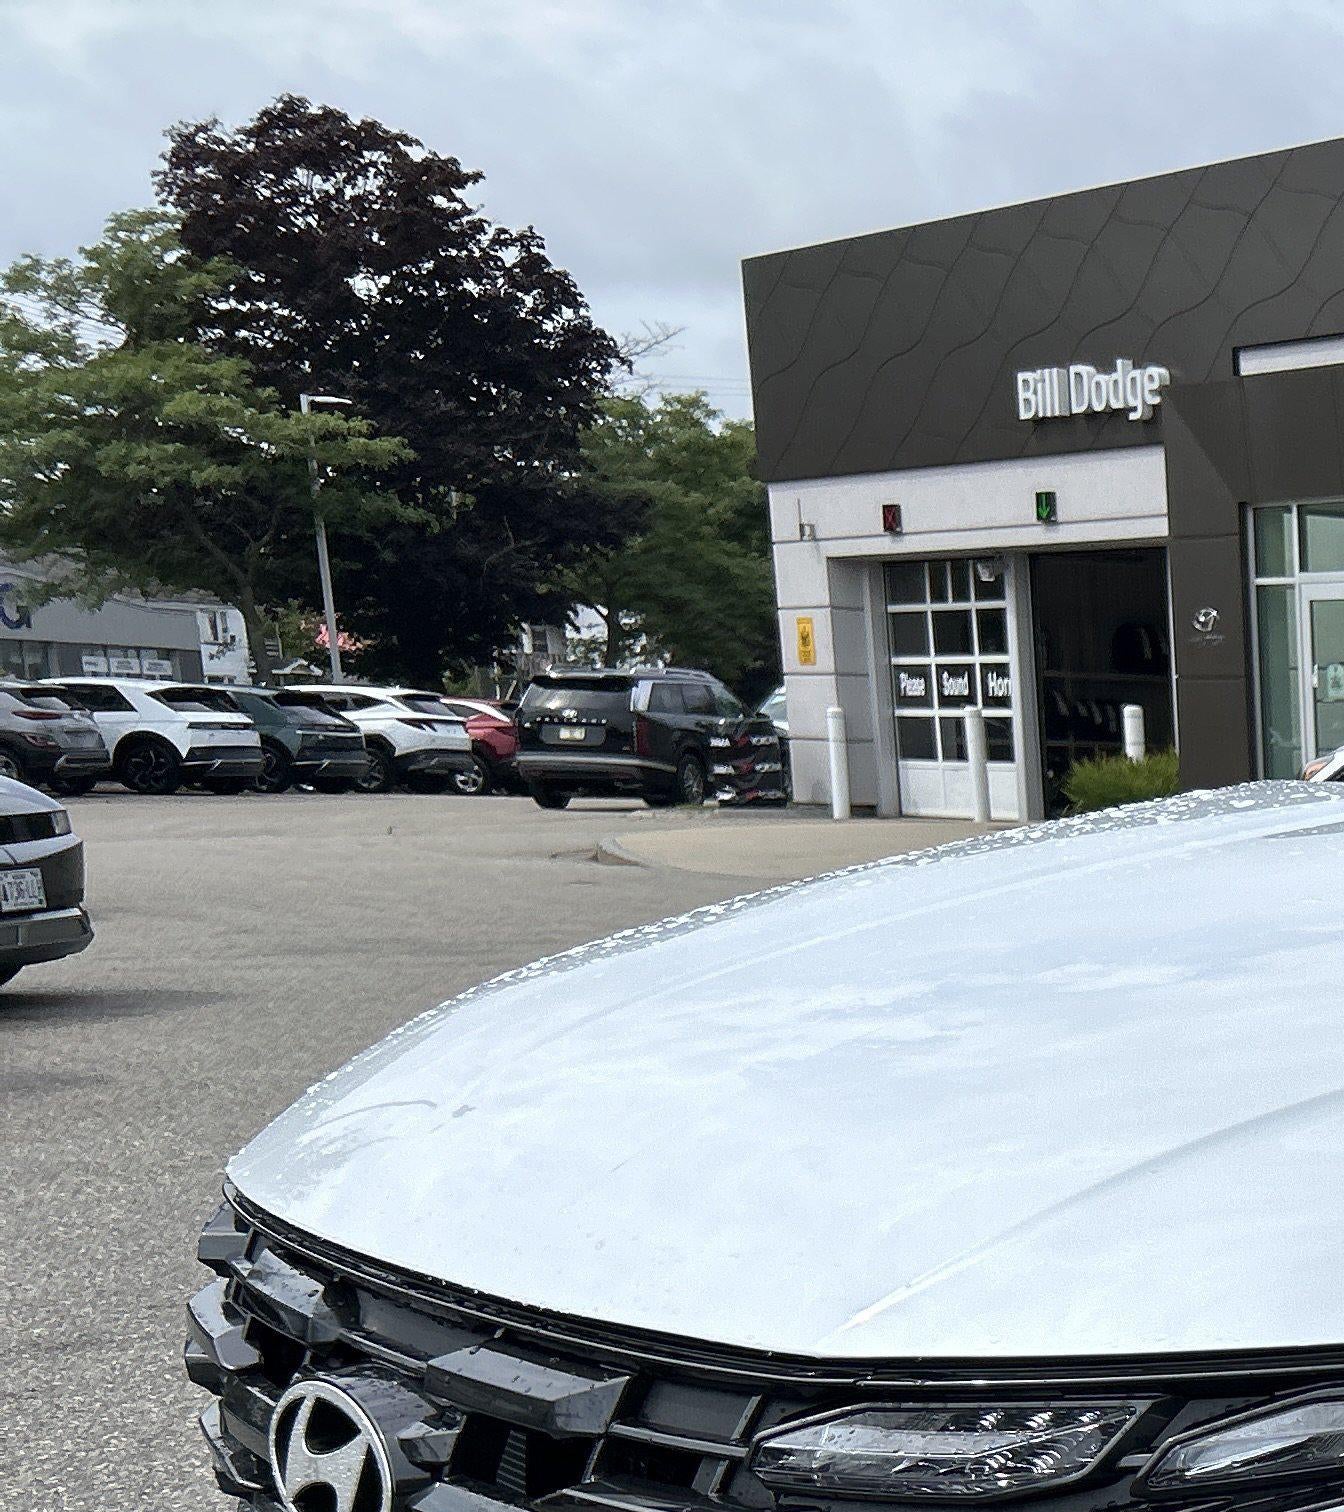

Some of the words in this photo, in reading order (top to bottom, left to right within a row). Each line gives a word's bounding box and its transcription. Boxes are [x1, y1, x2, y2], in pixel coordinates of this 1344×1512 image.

[1017, 368, 1070, 420] Bill
[1069, 358, 1171, 420] Dodge
[942, 671, 969, 697] Sound
